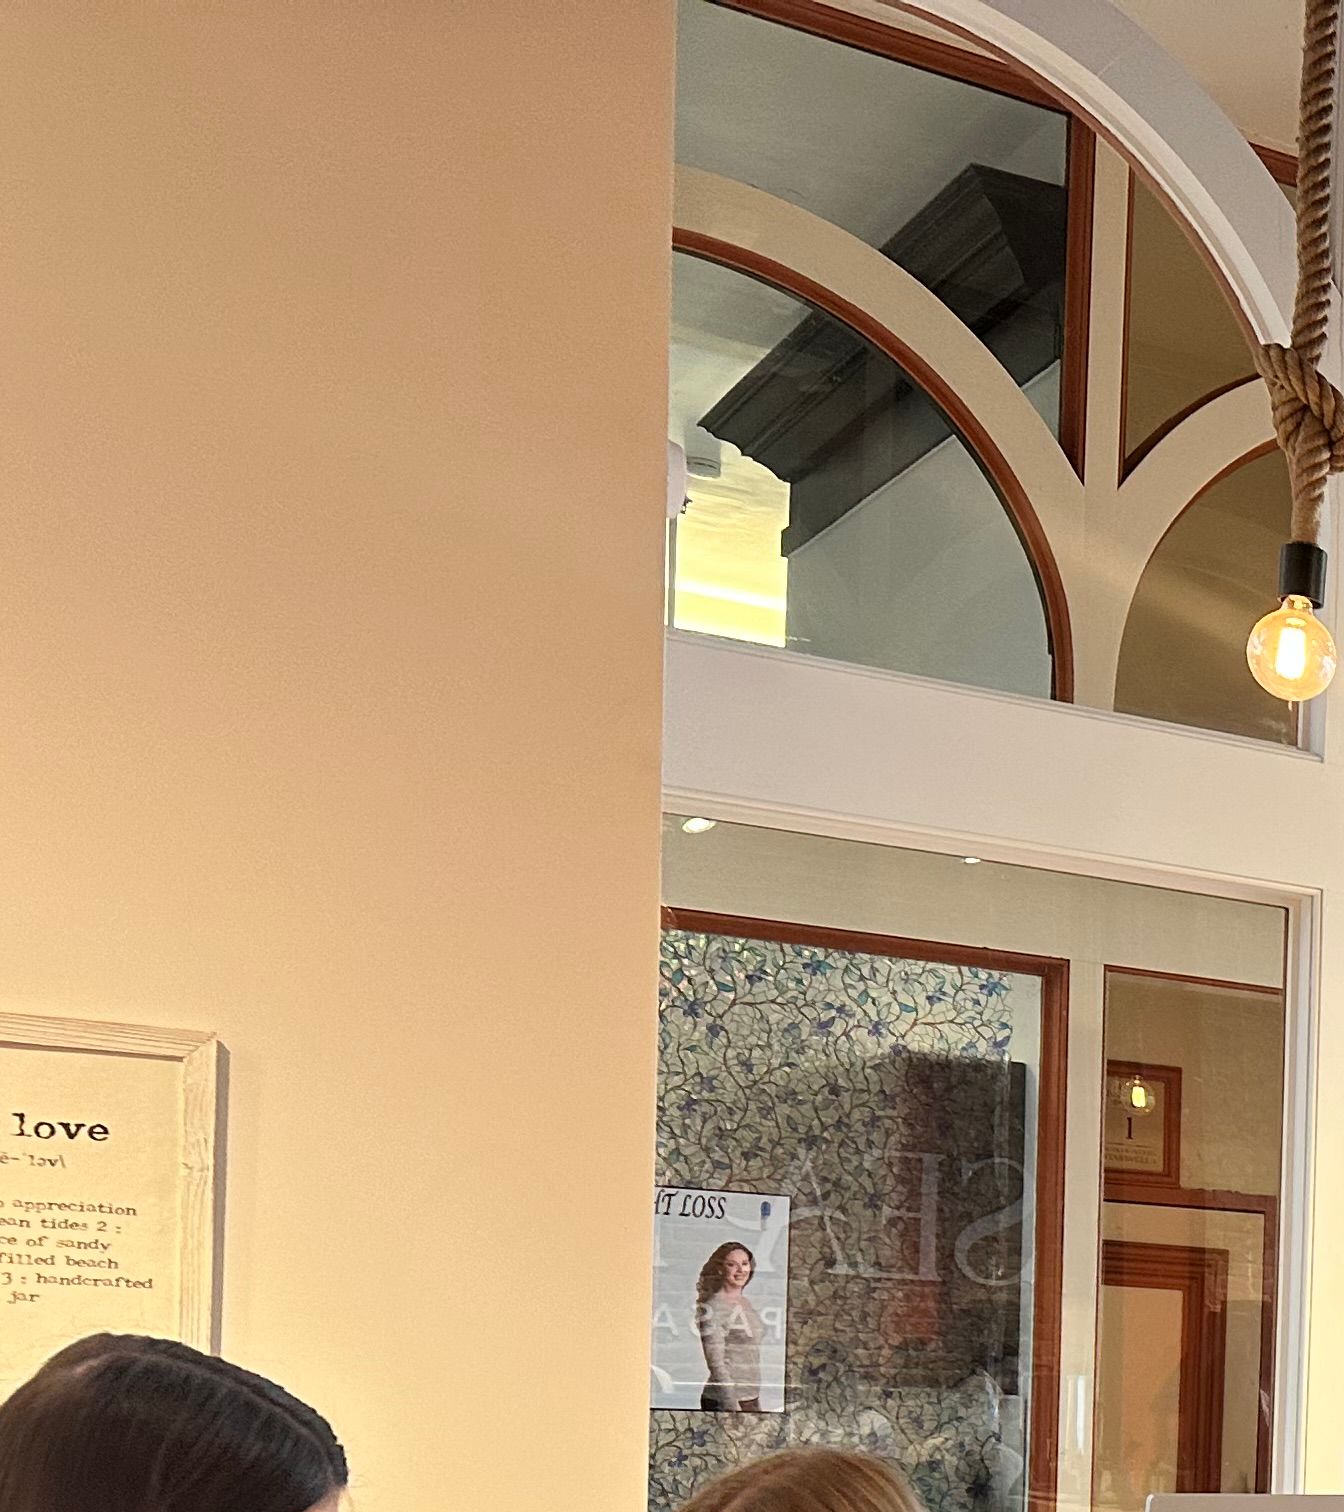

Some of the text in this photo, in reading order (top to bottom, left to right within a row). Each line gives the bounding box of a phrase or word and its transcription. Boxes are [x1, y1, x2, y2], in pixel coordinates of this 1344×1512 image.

[10, 1112, 110, 1141] love
[12, 1199, 137, 1216] appreciation
[679, 1194, 727, 1219] LOSS
[40, 1219, 88, 1231] tides
[96, 1221, 107, 1232] 2
[26, 1235, 49, 1247] of
[56, 1239, 111, 1253] sandy
[64, 1255, 119, 1269] beach
[1, 1272, 12, 1285] 3
[36, 1272, 153, 1289] handcrafted
[7, 1291, 40, 1304] jar
